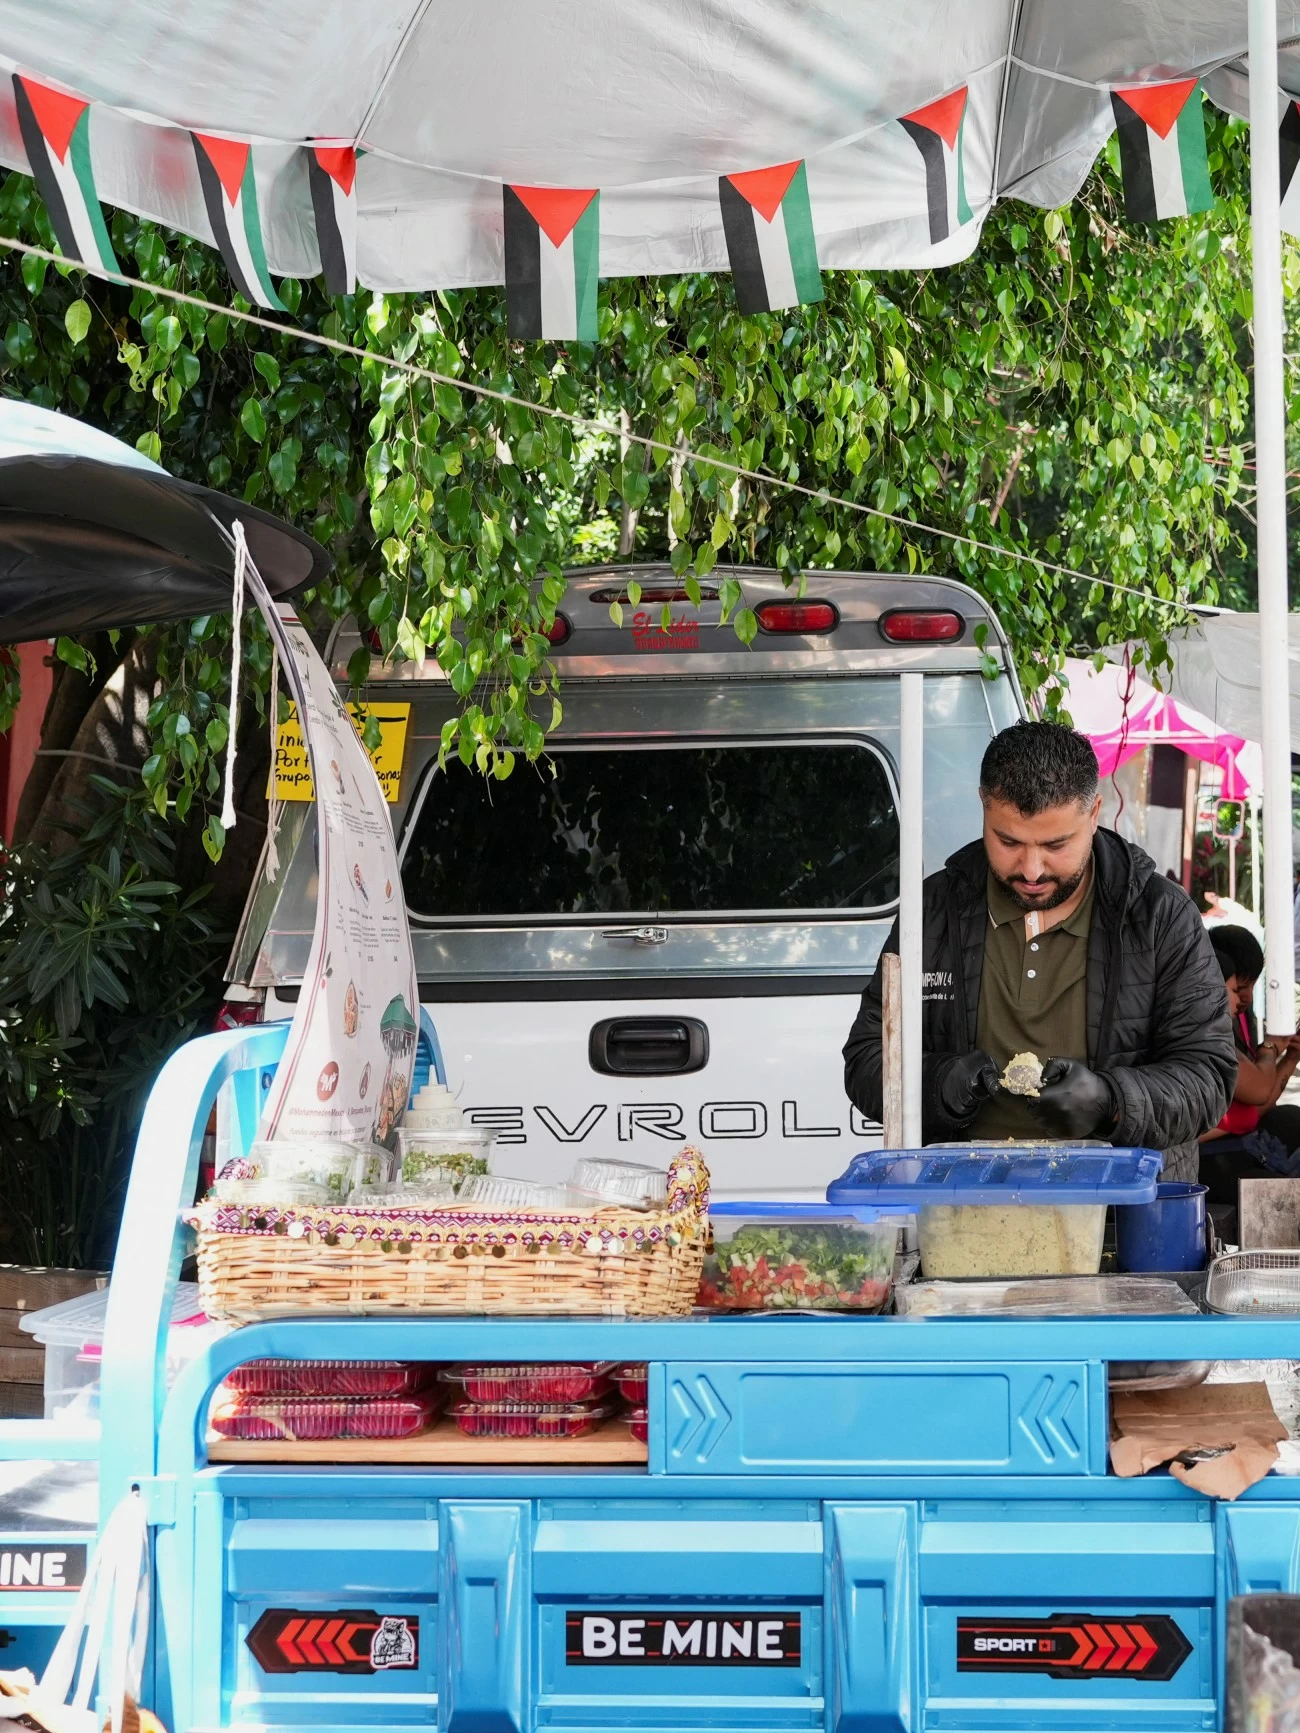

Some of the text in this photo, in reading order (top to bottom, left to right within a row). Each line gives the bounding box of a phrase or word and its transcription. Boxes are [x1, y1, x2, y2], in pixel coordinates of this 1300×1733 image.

[656, 613, 699, 634] ider
[0, 1552, 67, 1587] INE
[582, 1616, 784, 1659] BE MINE
[973, 1637, 1037, 1652] SPORT
[374, 1653, 410, 1664] BE MINE
